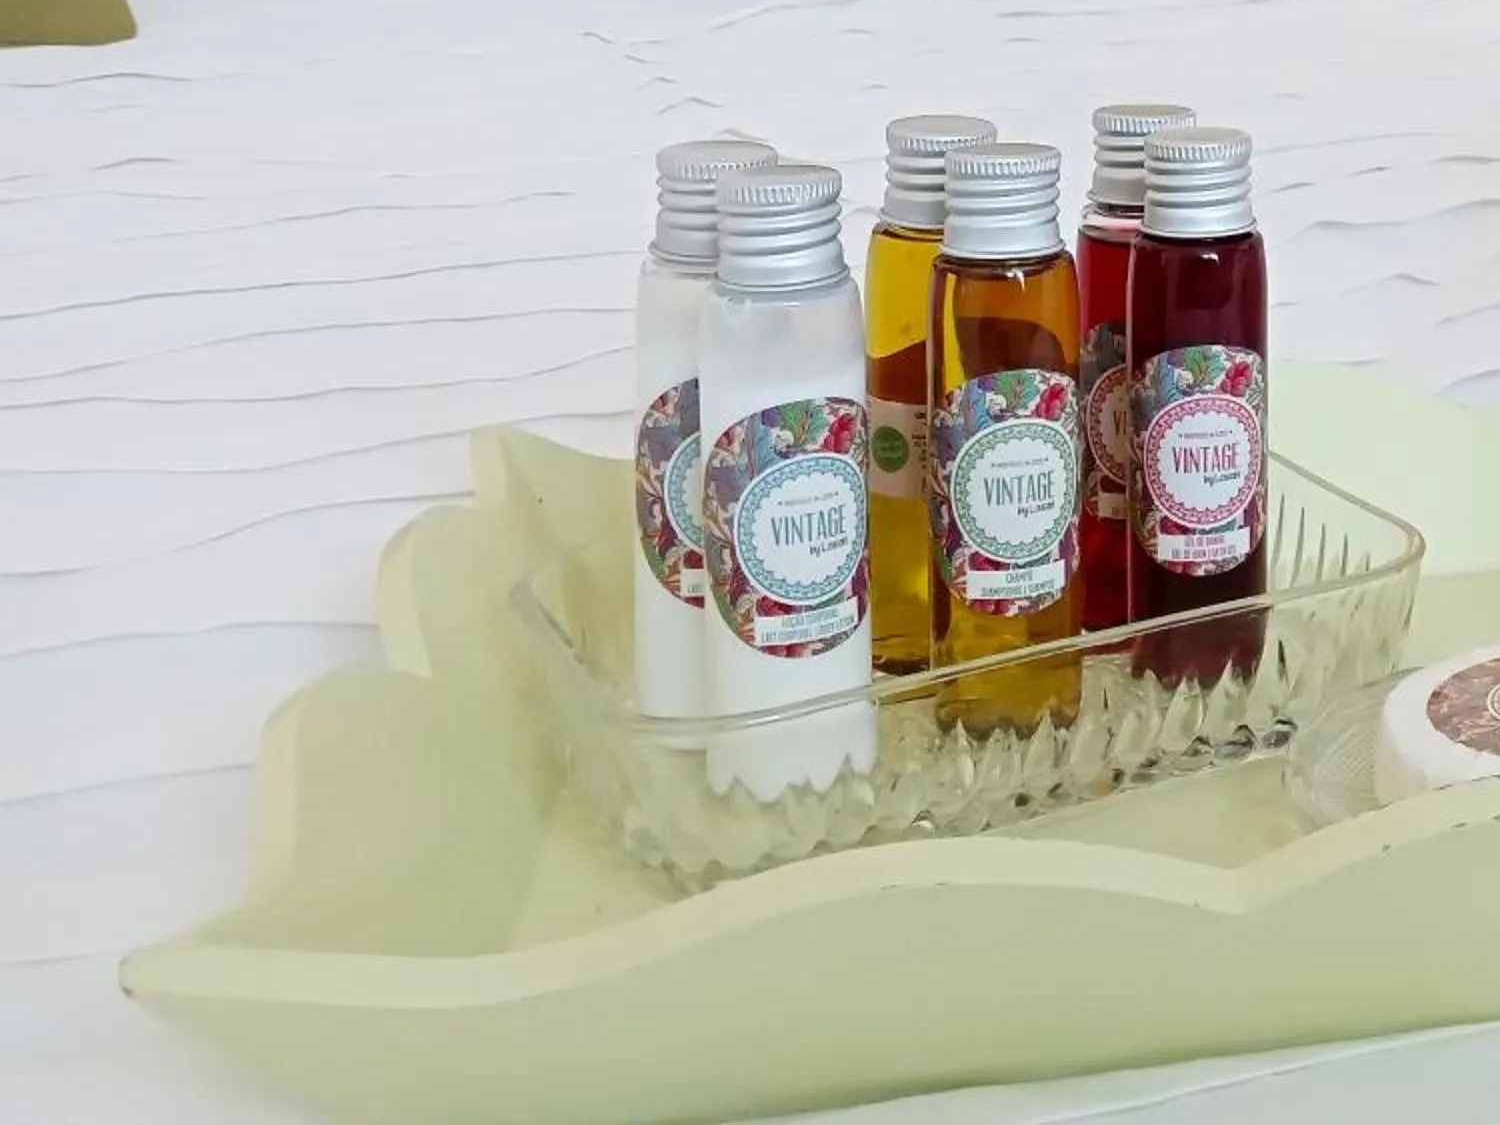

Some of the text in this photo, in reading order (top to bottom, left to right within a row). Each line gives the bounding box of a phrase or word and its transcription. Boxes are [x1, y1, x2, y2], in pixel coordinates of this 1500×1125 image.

[1171, 441, 1239, 474] VINTAGE
[983, 470, 1056, 508] VINTAGE
[771, 503, 847, 548] VINTAGE
